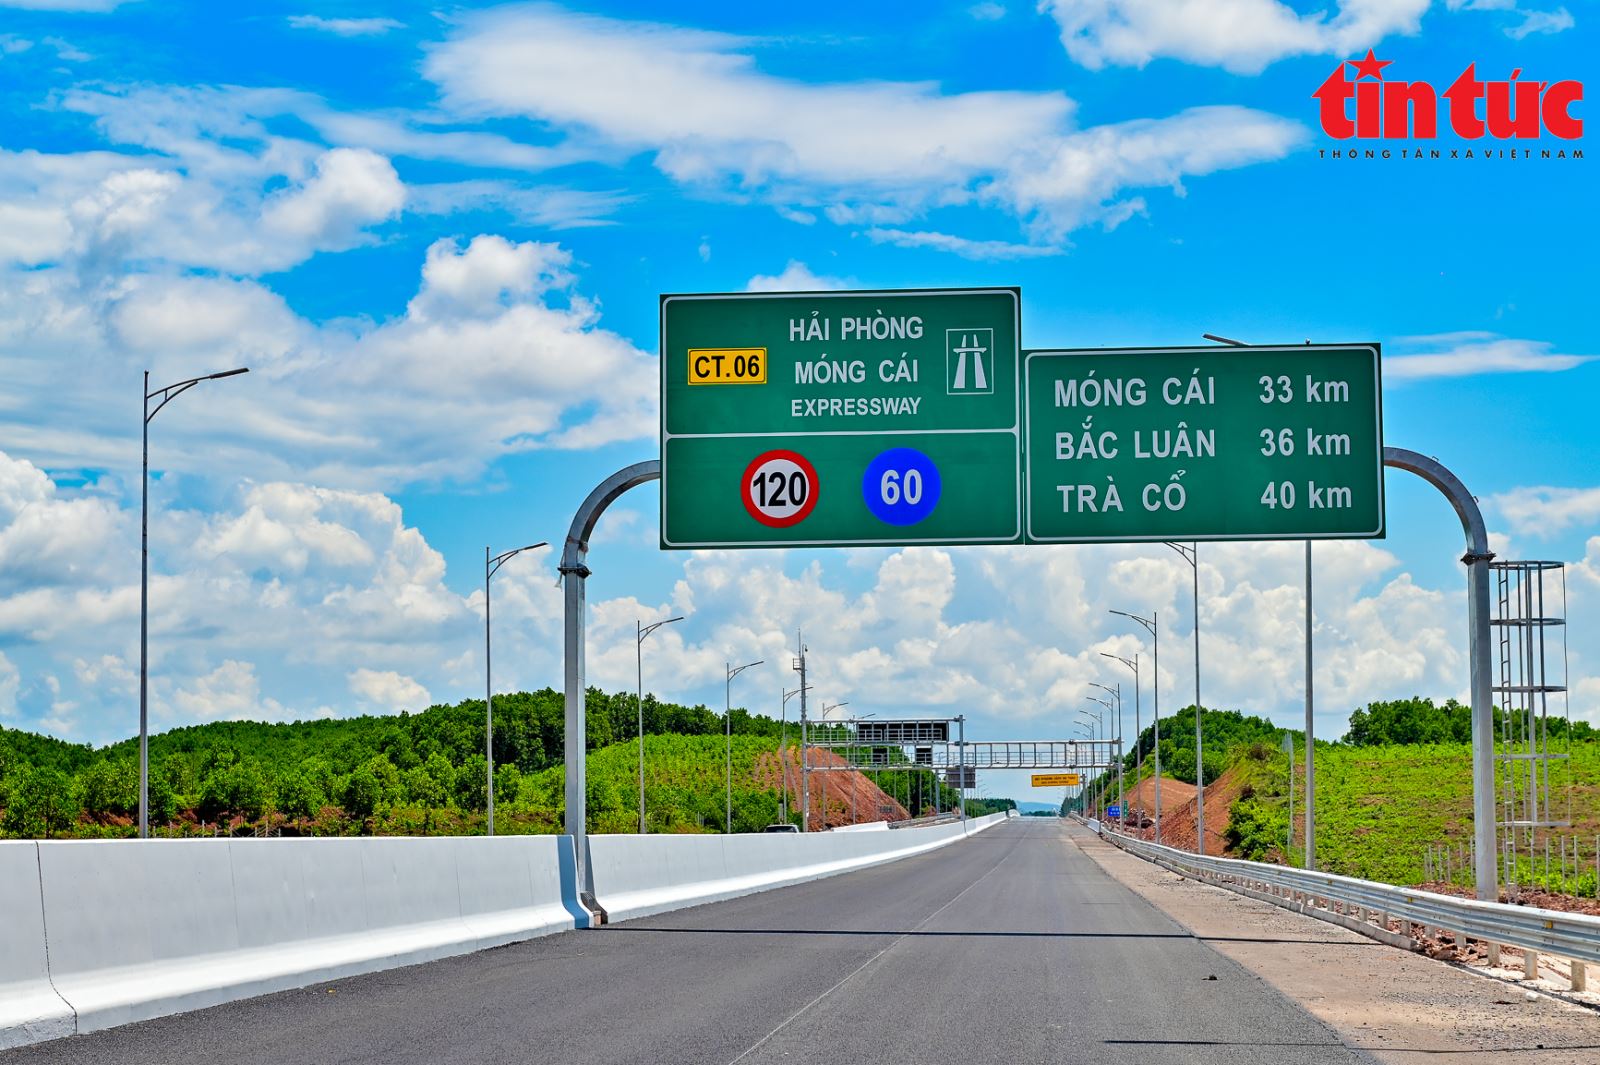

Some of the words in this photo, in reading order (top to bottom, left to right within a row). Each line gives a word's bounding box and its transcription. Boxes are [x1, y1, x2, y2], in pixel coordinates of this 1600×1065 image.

[790, 311, 830, 341] HẢI
[841, 309, 923, 340] PHÒNG
[694, 355, 760, 378] CT.06
[795, 354, 865, 384] MÓNG
[879, 353, 918, 382] CÁI
[1055, 370, 1146, 407] MÓNG
[1162, 368, 1214, 405] CÁI
[1259, 375, 1293, 403] 33
[1306, 375, 1349, 402] km
[792, 397, 921, 417] EXPRESSWAY
[1055, 416, 1118, 460] BẮC
[1135, 422, 1215, 458] LUÂN
[1260, 428, 1294, 456] 36
[1307, 428, 1350, 456] km
[753, 471, 806, 507] 120
[881, 469, 922, 505] 60
[1057, 476, 1124, 513] TRÀ
[1142, 470, 1186, 511] CỔ
[1260, 481, 1295, 509] 40
[1309, 481, 1352, 509] km
